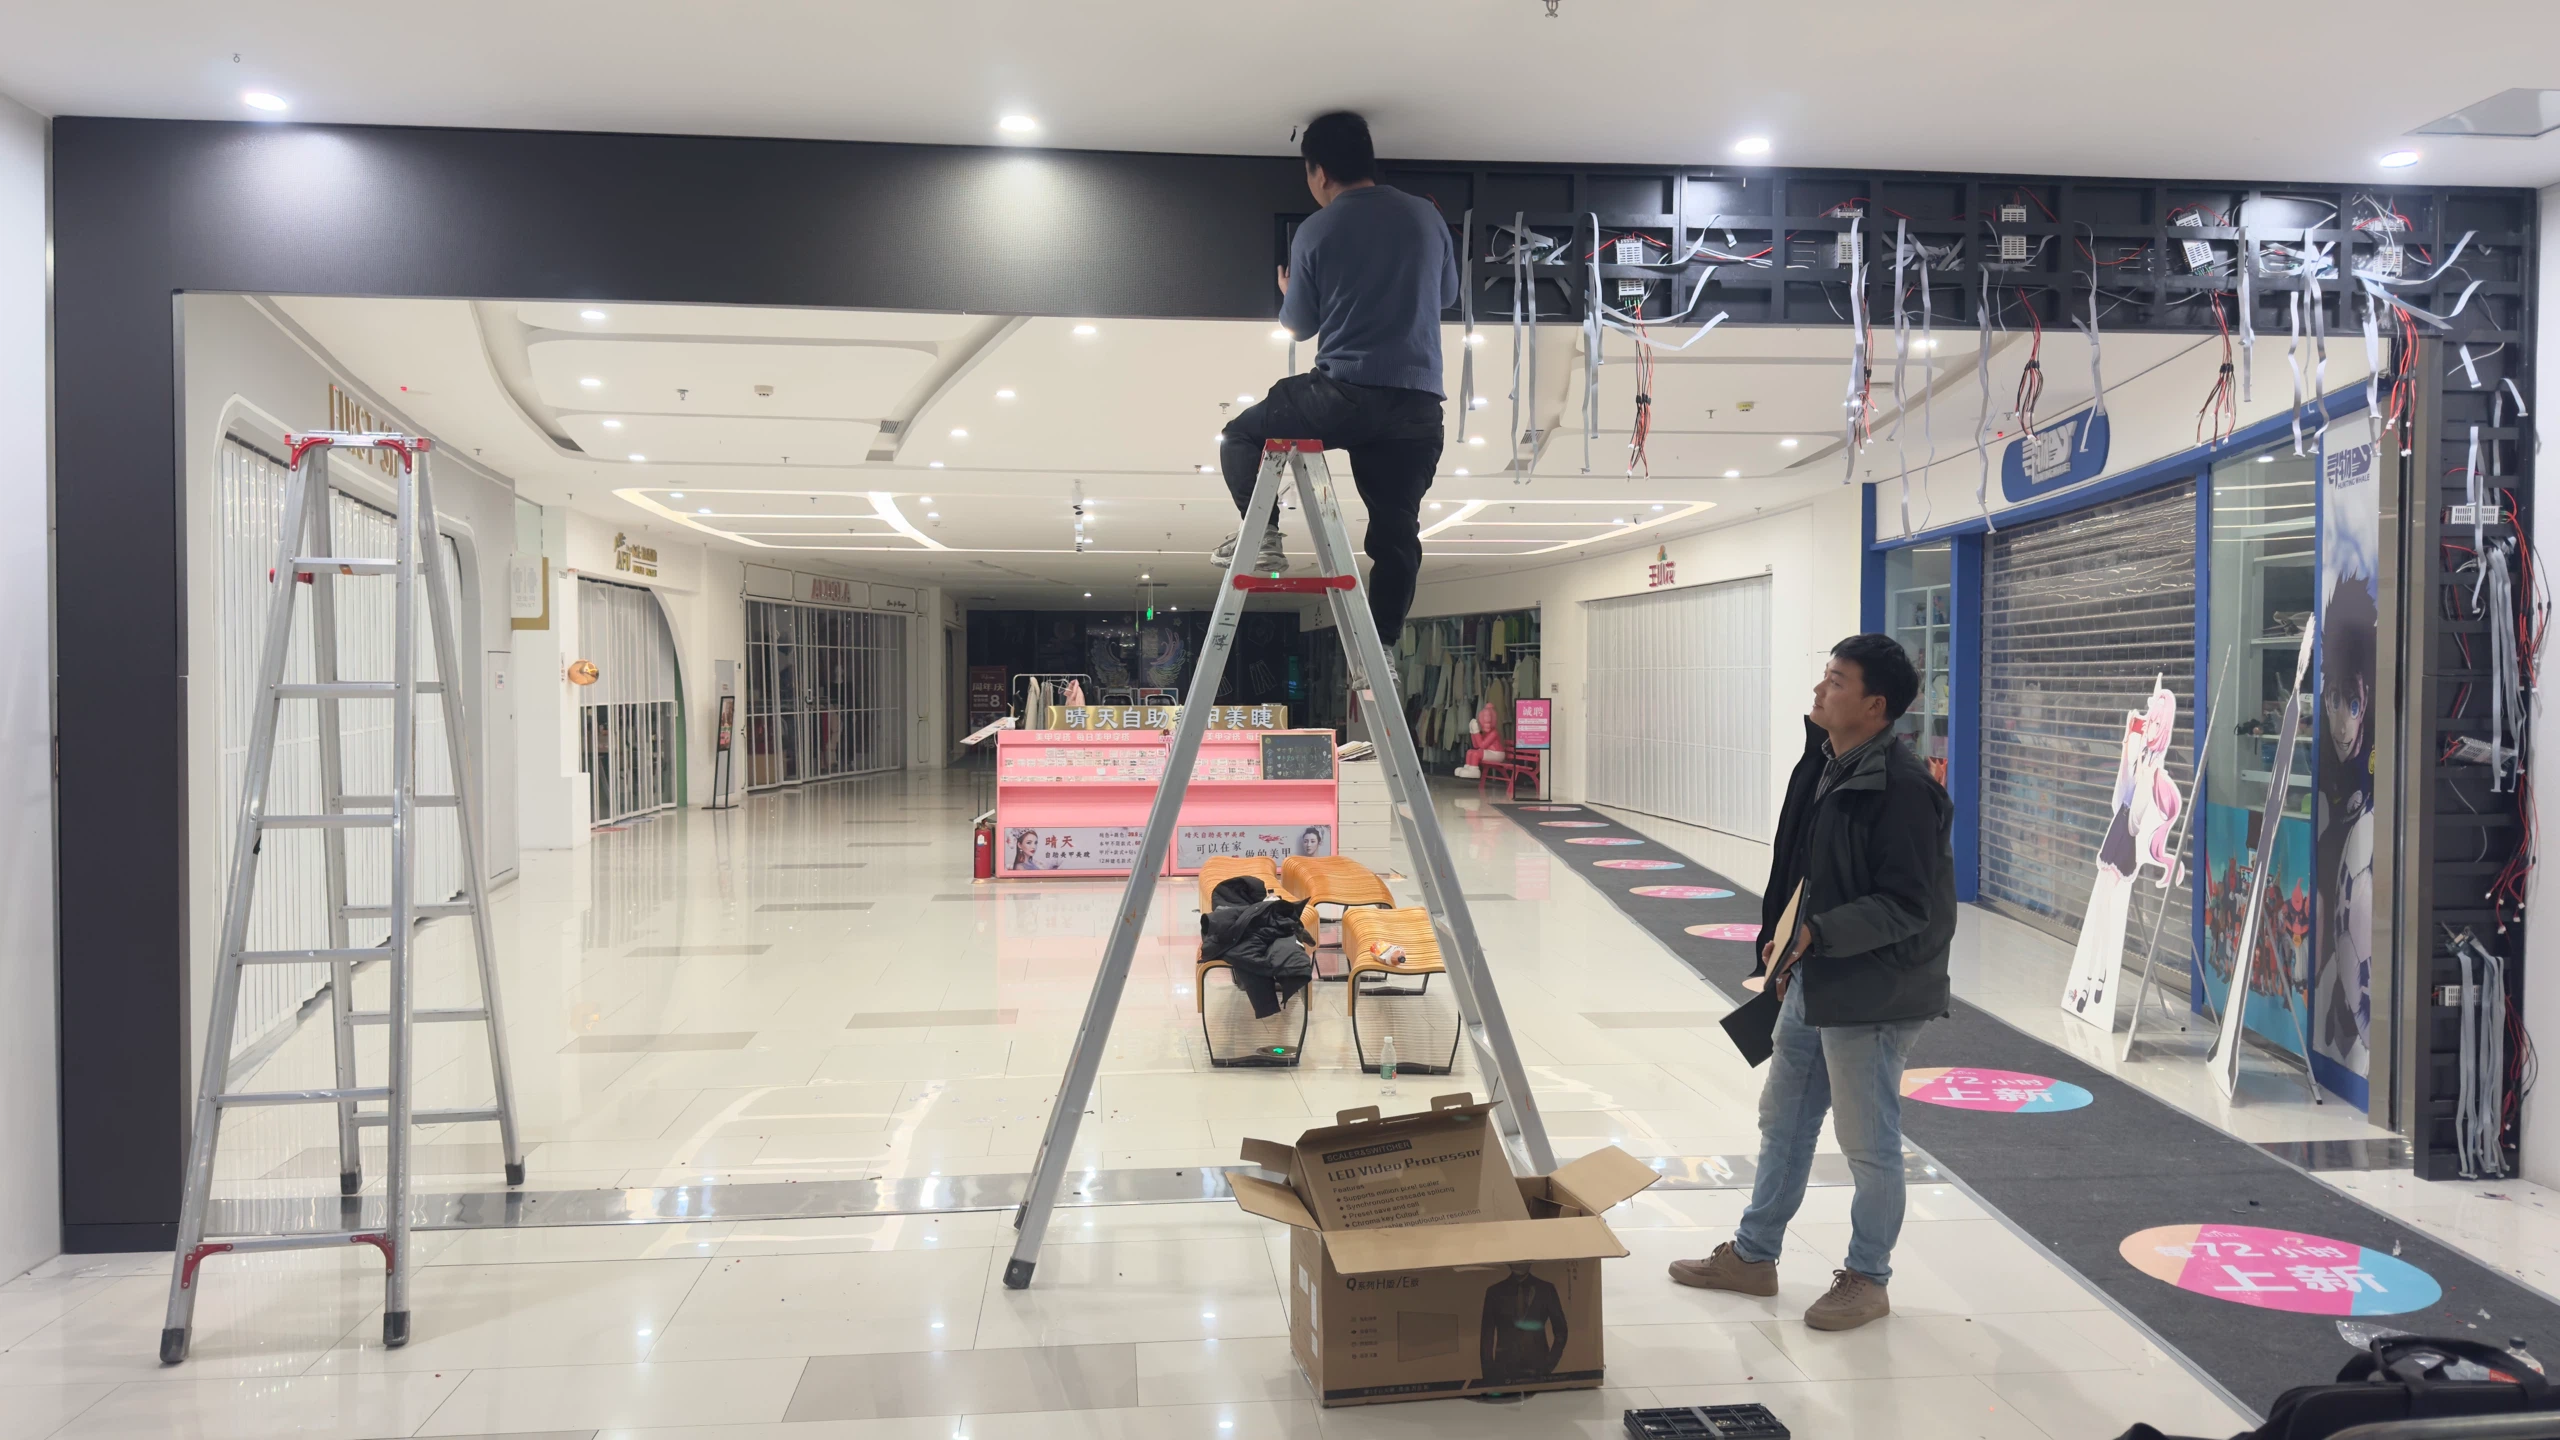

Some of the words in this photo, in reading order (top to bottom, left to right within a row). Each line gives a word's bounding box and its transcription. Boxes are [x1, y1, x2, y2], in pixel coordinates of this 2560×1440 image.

[972, 683, 1004, 691] 周年庆
[990, 694, 1000, 707] 8
[1045, 835, 1074, 848] 晴天
[1196, 841, 1242, 854] 可以在家
[1246, 848, 1291, 859] 做的美甲
[1932, 1087, 2054, 1103] 上新
[1327, 1141, 1410, 1162] SCALER&SWITCHER
[1328, 1169, 1356, 1182] LED
[1358, 1163, 1402, 1177] Video
[1404, 1149, 1481, 1168] Processor
[1333, 1184, 1365, 1194] Features
[1343, 1192, 1375, 1203] Supports
[1376, 1187, 1399, 1197] million
[1400, 1184, 1418, 1193] pixel
[1419, 1180, 1440, 1189] scaler
[1346, 1197, 1394, 1212] Synchronous
[1396, 1191, 1426, 1202] cascade
[1427, 1186, 1455, 1197] splicing
[1348, 1209, 1373, 1219] Preset
[1374, 1207, 1391, 1215] save
[1392, 1204, 1406, 1213] and
[1407, 1201, 1420, 1210] call
[1404, 1215, 1445, 1227] input/output
[1446, 1208, 1481, 1220] resolution
[1352, 1218, 1381, 1228] Chroma
[1381, 1215, 1394, 1224] key
[2214, 1264, 2388, 1293] 上新
